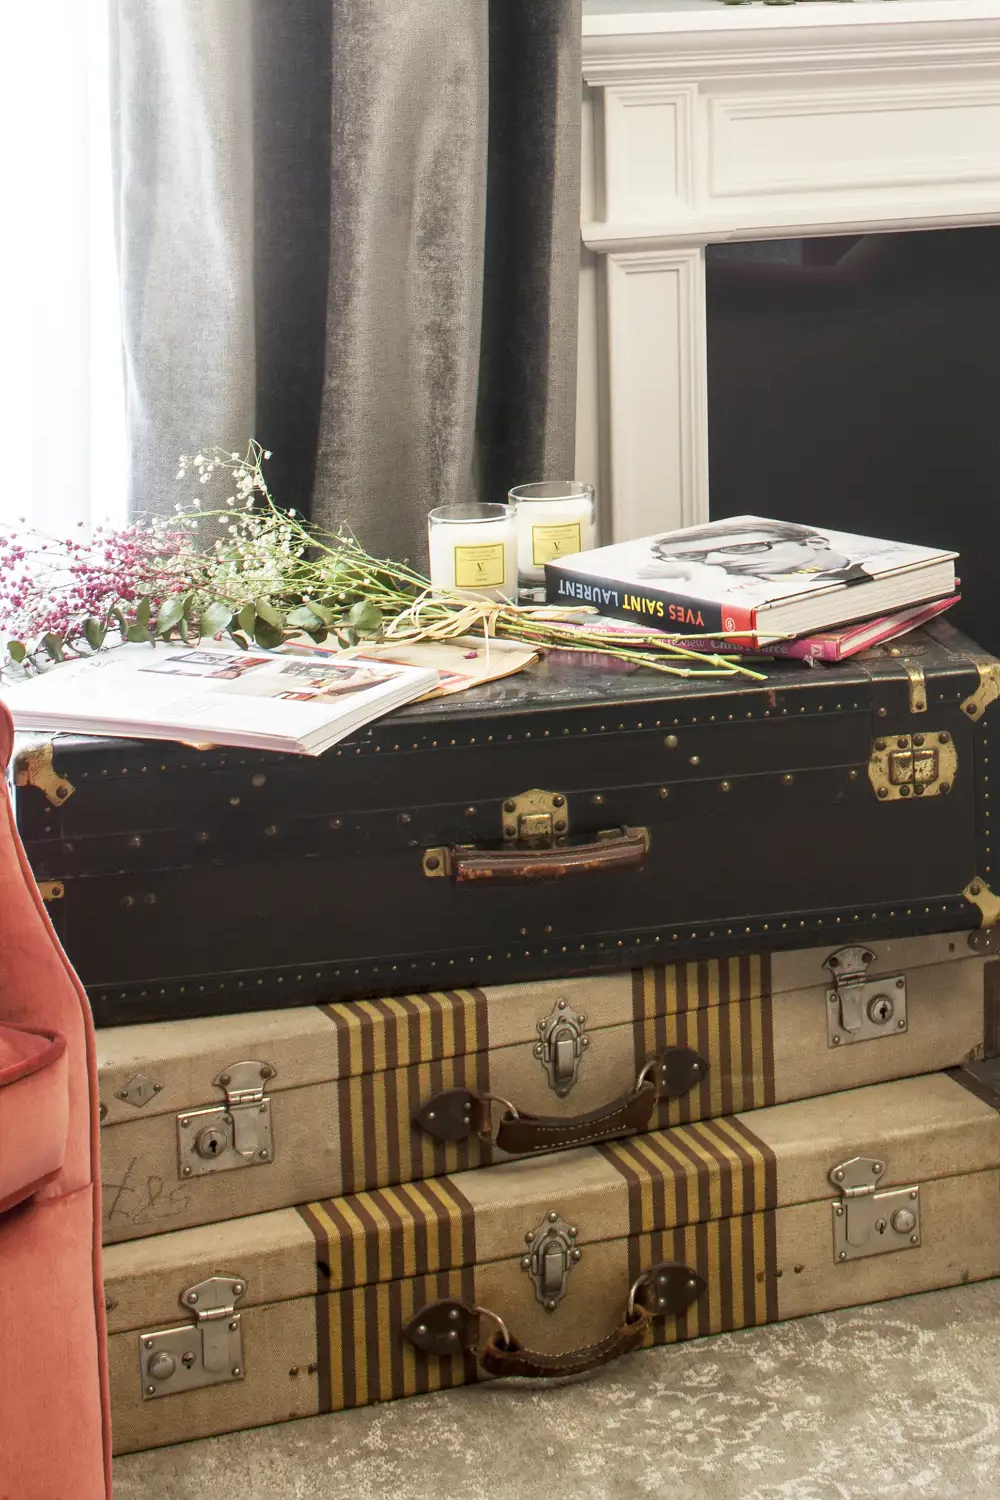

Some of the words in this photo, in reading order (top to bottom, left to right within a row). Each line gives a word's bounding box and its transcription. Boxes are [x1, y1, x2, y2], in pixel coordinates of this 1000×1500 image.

[557, 579, 619, 607] LAURENT
[622, 594, 664, 618] SAINT
[668, 603, 705, 627] YVES
